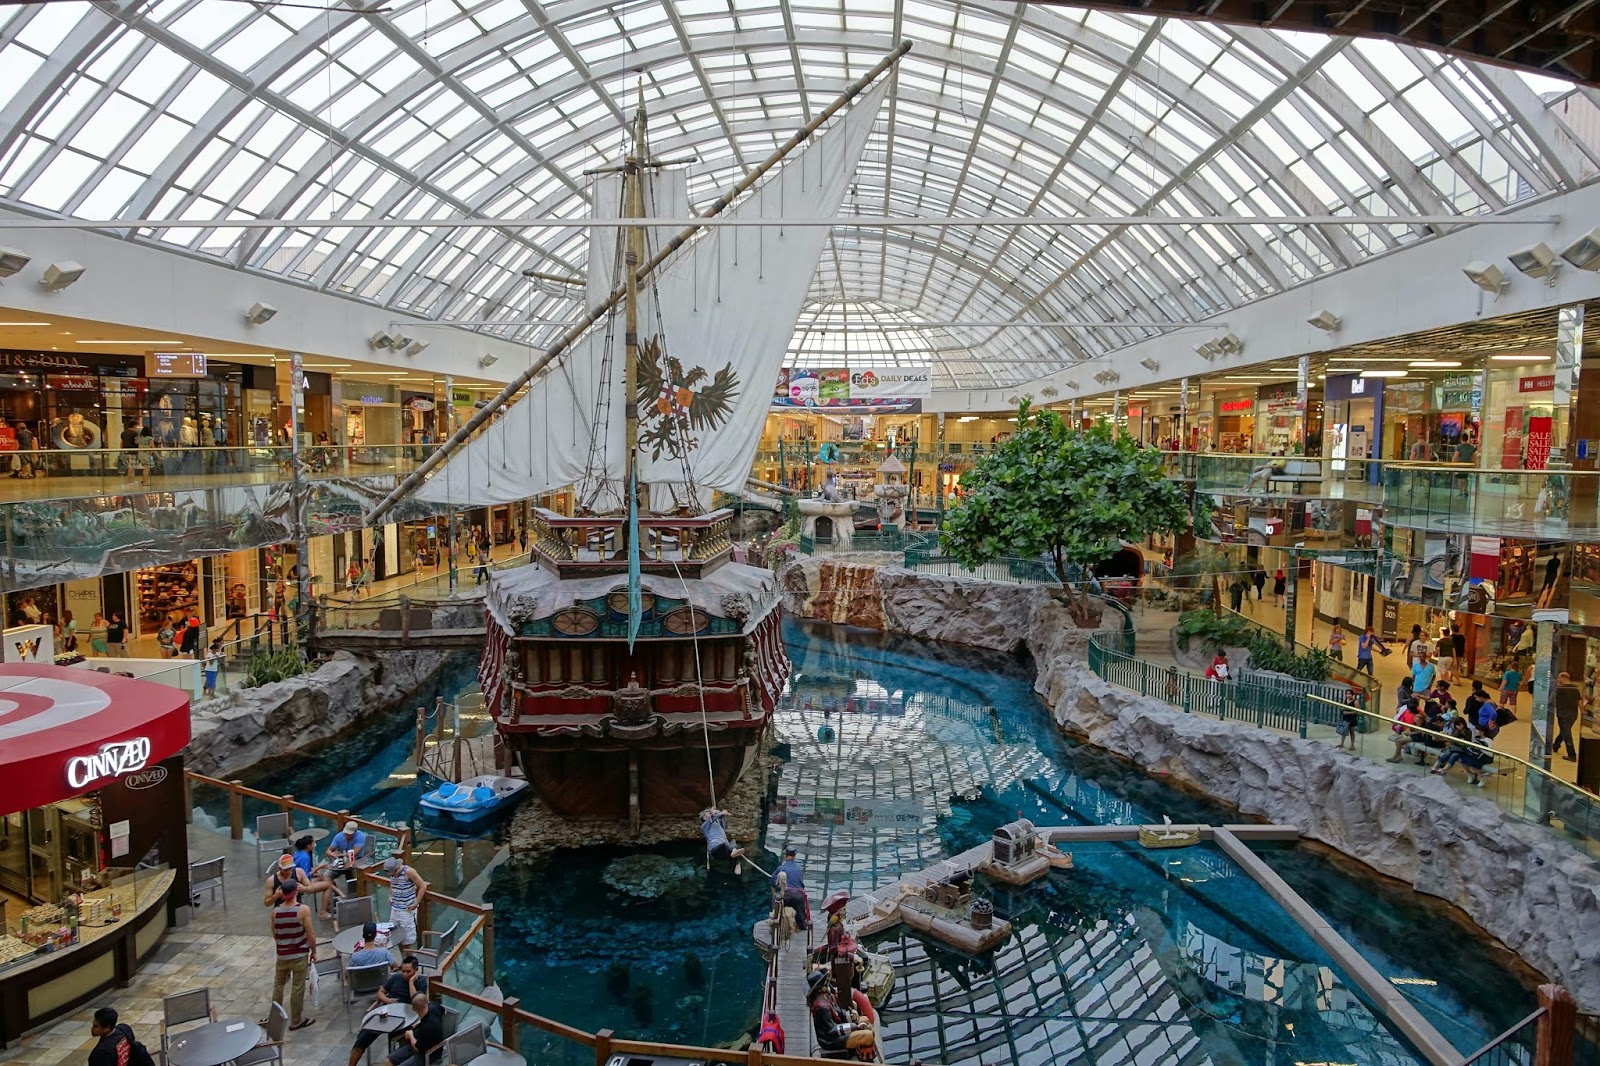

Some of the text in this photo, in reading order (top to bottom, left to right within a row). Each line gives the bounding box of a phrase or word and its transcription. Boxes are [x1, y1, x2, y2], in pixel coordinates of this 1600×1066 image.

[854, 374, 876, 385] Ed's
[1530, 432, 1551, 440] SALE
[1529, 439, 1551, 448] SALE
[1528, 447, 1550, 455] SALE
